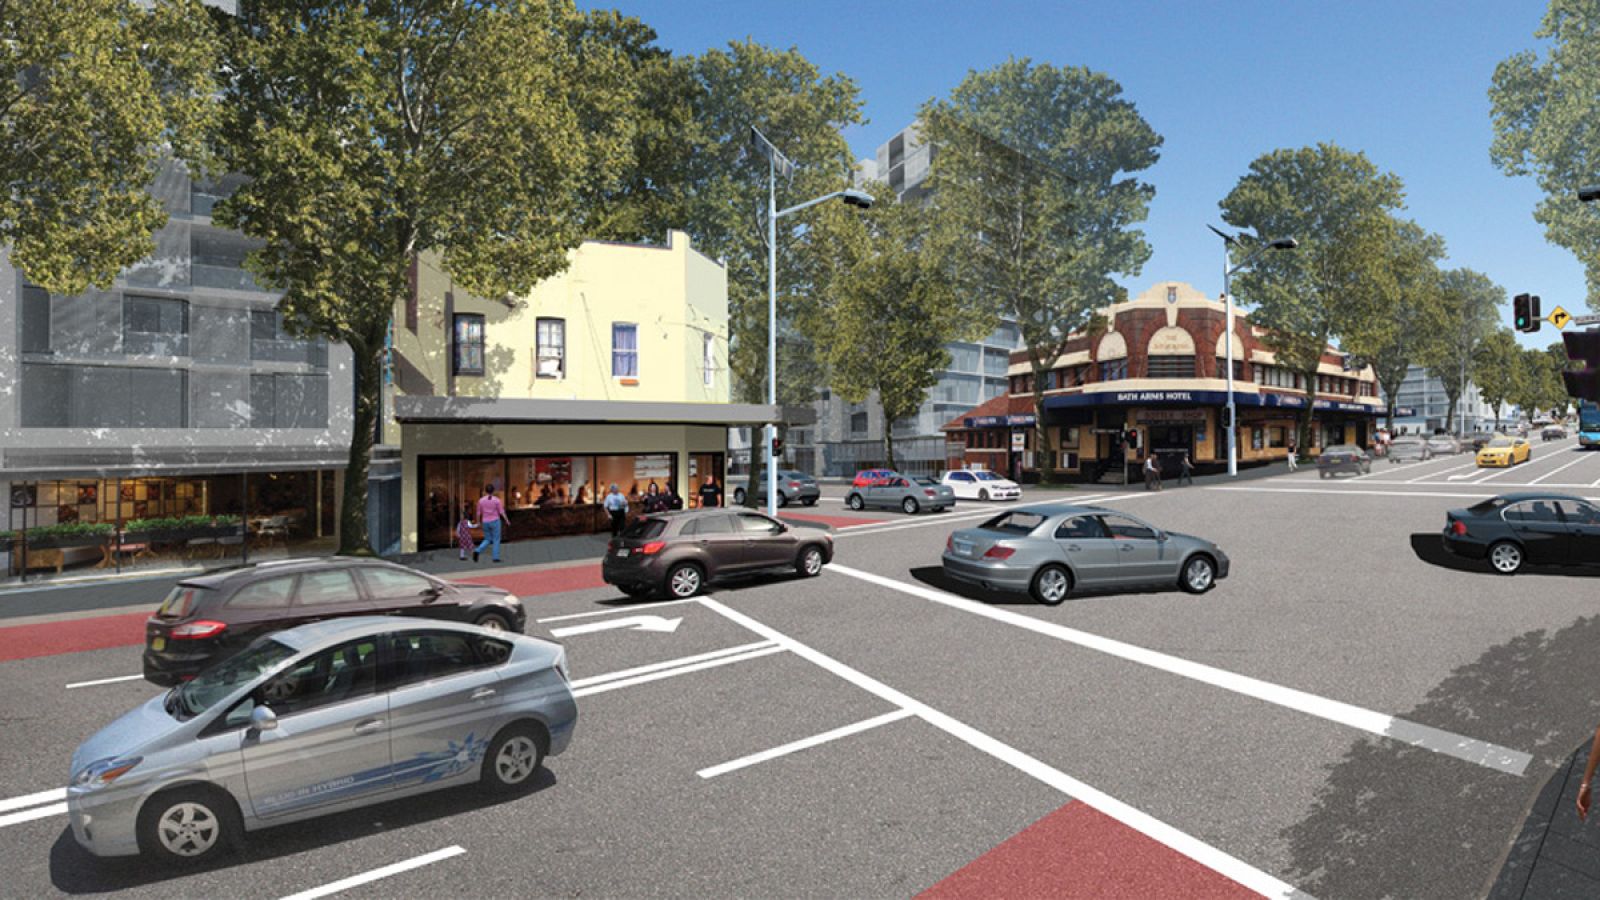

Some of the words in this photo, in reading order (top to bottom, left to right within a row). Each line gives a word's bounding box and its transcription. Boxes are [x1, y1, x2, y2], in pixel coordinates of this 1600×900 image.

[1117, 393, 1138, 401] BATH
[1140, 392, 1164, 400] ARMS
[1166, 392, 1191, 400] HOTEL
